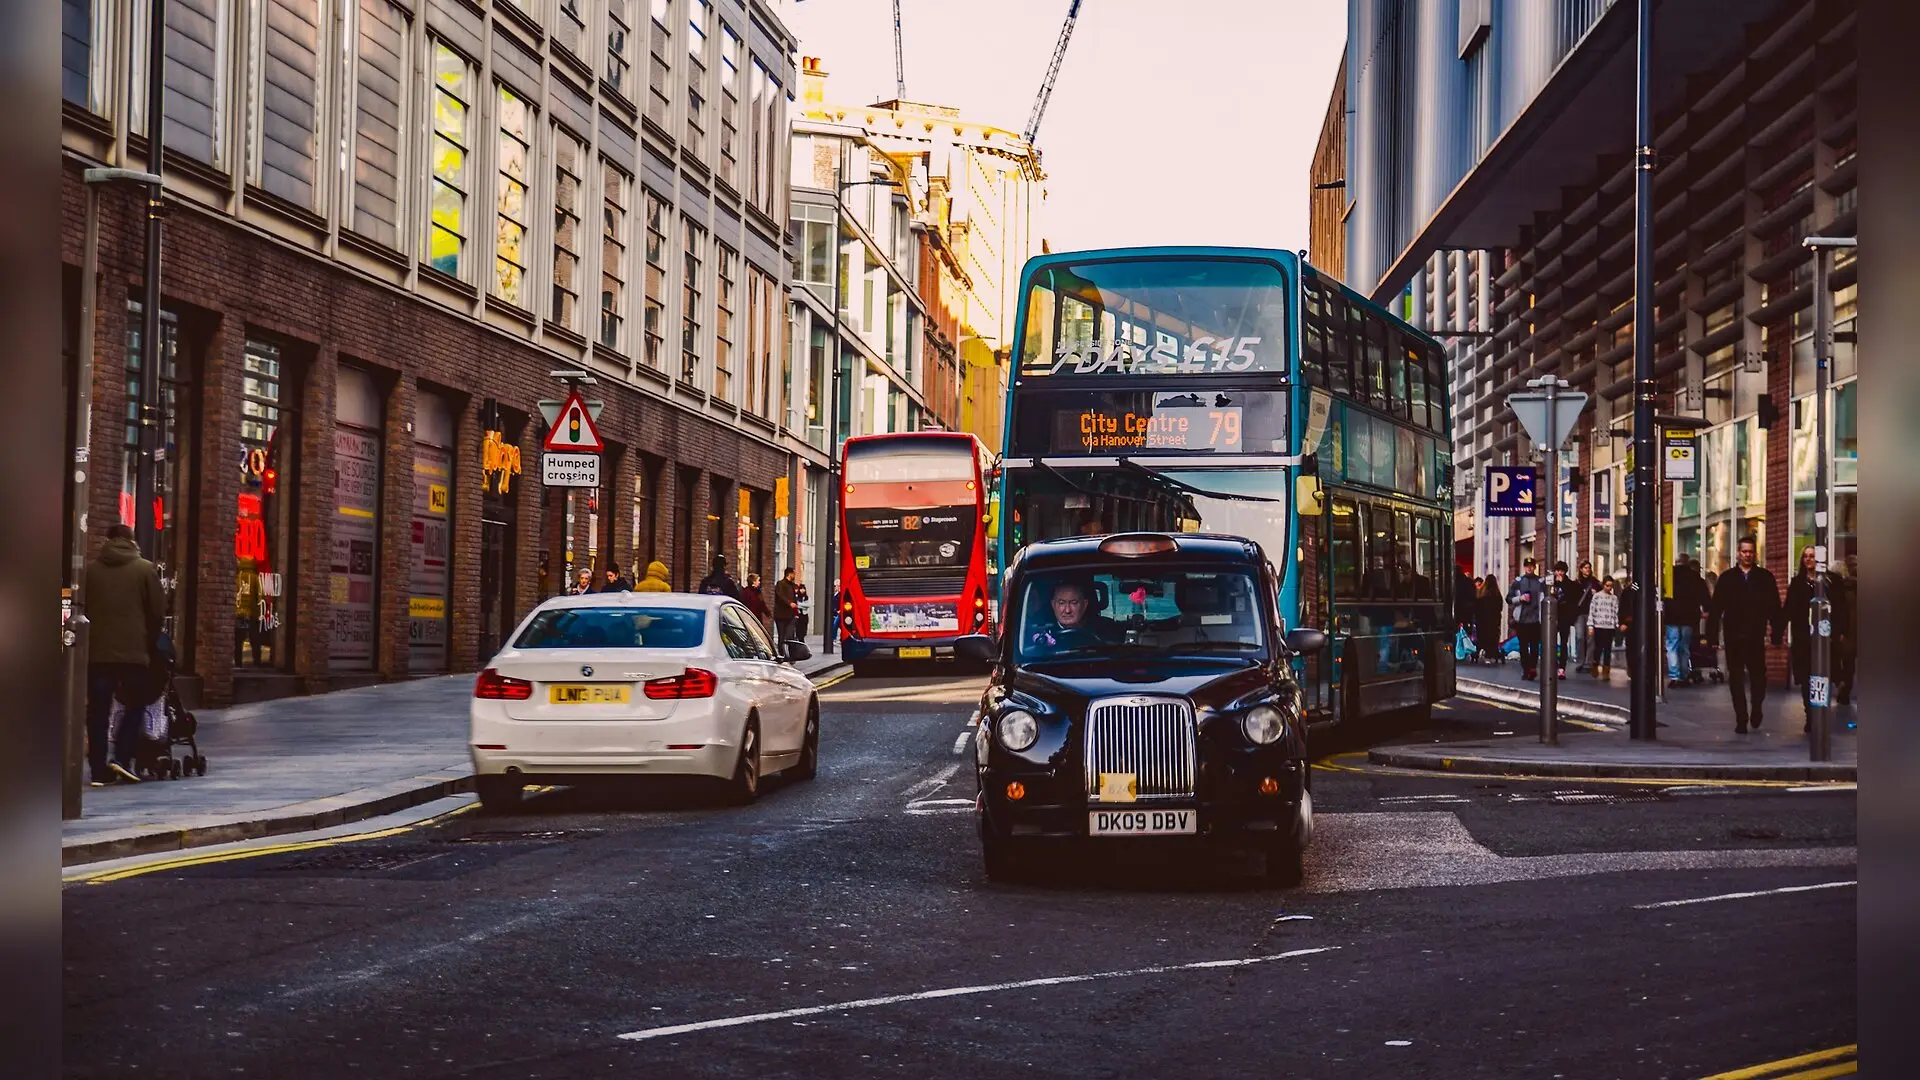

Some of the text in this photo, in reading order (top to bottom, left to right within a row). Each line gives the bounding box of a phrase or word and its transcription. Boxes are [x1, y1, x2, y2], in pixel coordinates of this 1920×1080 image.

[1051, 348, 1074, 374] 7
[1074, 345, 1175, 374] DAYS
[1080, 411, 1239, 445] City Centre 79
[1081, 434, 1188, 447] via Hanover Street
[351, 462, 376, 481] SOURCE
[548, 458, 595, 469] Humped
[548, 471, 595, 482] crossing
[1491, 473, 1510, 502] P
[432, 489, 445, 508] DELI
[904, 515, 920, 530] 82
[1098, 813, 1189, 830] DK09 DBV
